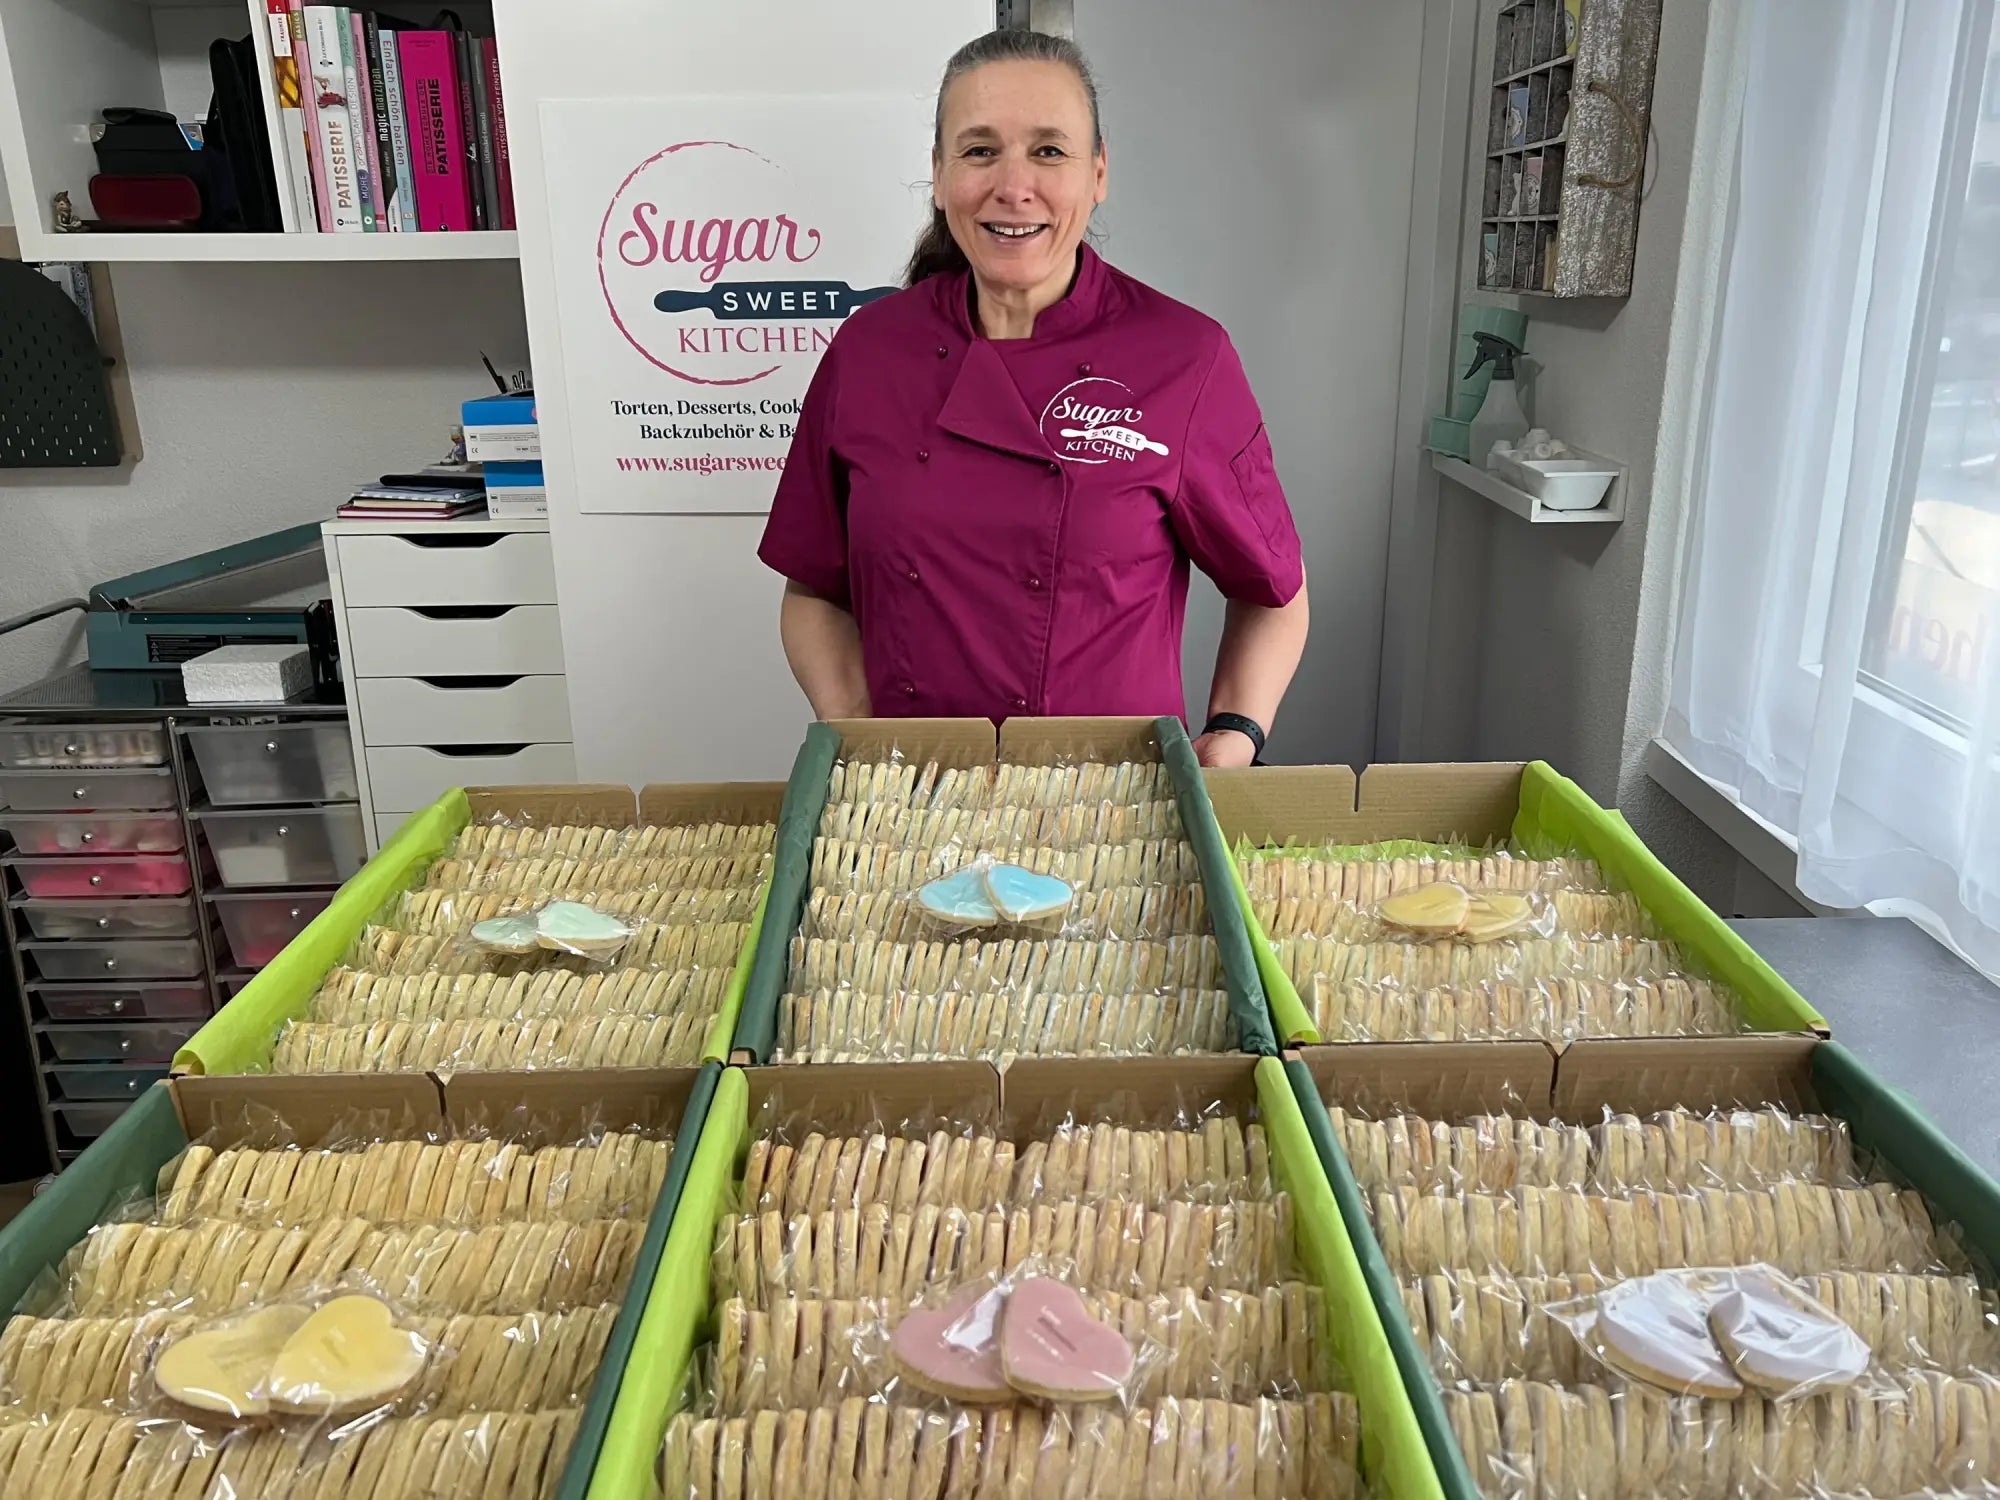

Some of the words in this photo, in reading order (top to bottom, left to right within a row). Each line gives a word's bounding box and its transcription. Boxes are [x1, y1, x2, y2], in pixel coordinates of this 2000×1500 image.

[383, 40, 396, 83] Einfach
[346, 77, 358, 110] DESIGN
[372, 68, 386, 112] marzipan
[389, 87, 401, 120] schön
[376, 113, 390, 142] magic
[428, 78, 448, 176] PATISSERIE
[393, 125, 405, 165] backen
[328, 121, 352, 208] PATISSERIE
[359, 174, 369, 200] MORE
[618, 202, 821, 283] Sugar
[722, 290, 840, 312] SWEET
[678, 326, 835, 353] KITCHEN
[610, 399, 673, 417] Torten,
[676, 399, 757, 417] Desserts,
[1052, 396, 1143, 429] Sugar
[639, 423, 755, 439] Backzubehör
[758, 423, 775, 439] &
[1091, 429, 1142, 447] SWEET
[1065, 440, 1136, 462] KITCHEN
